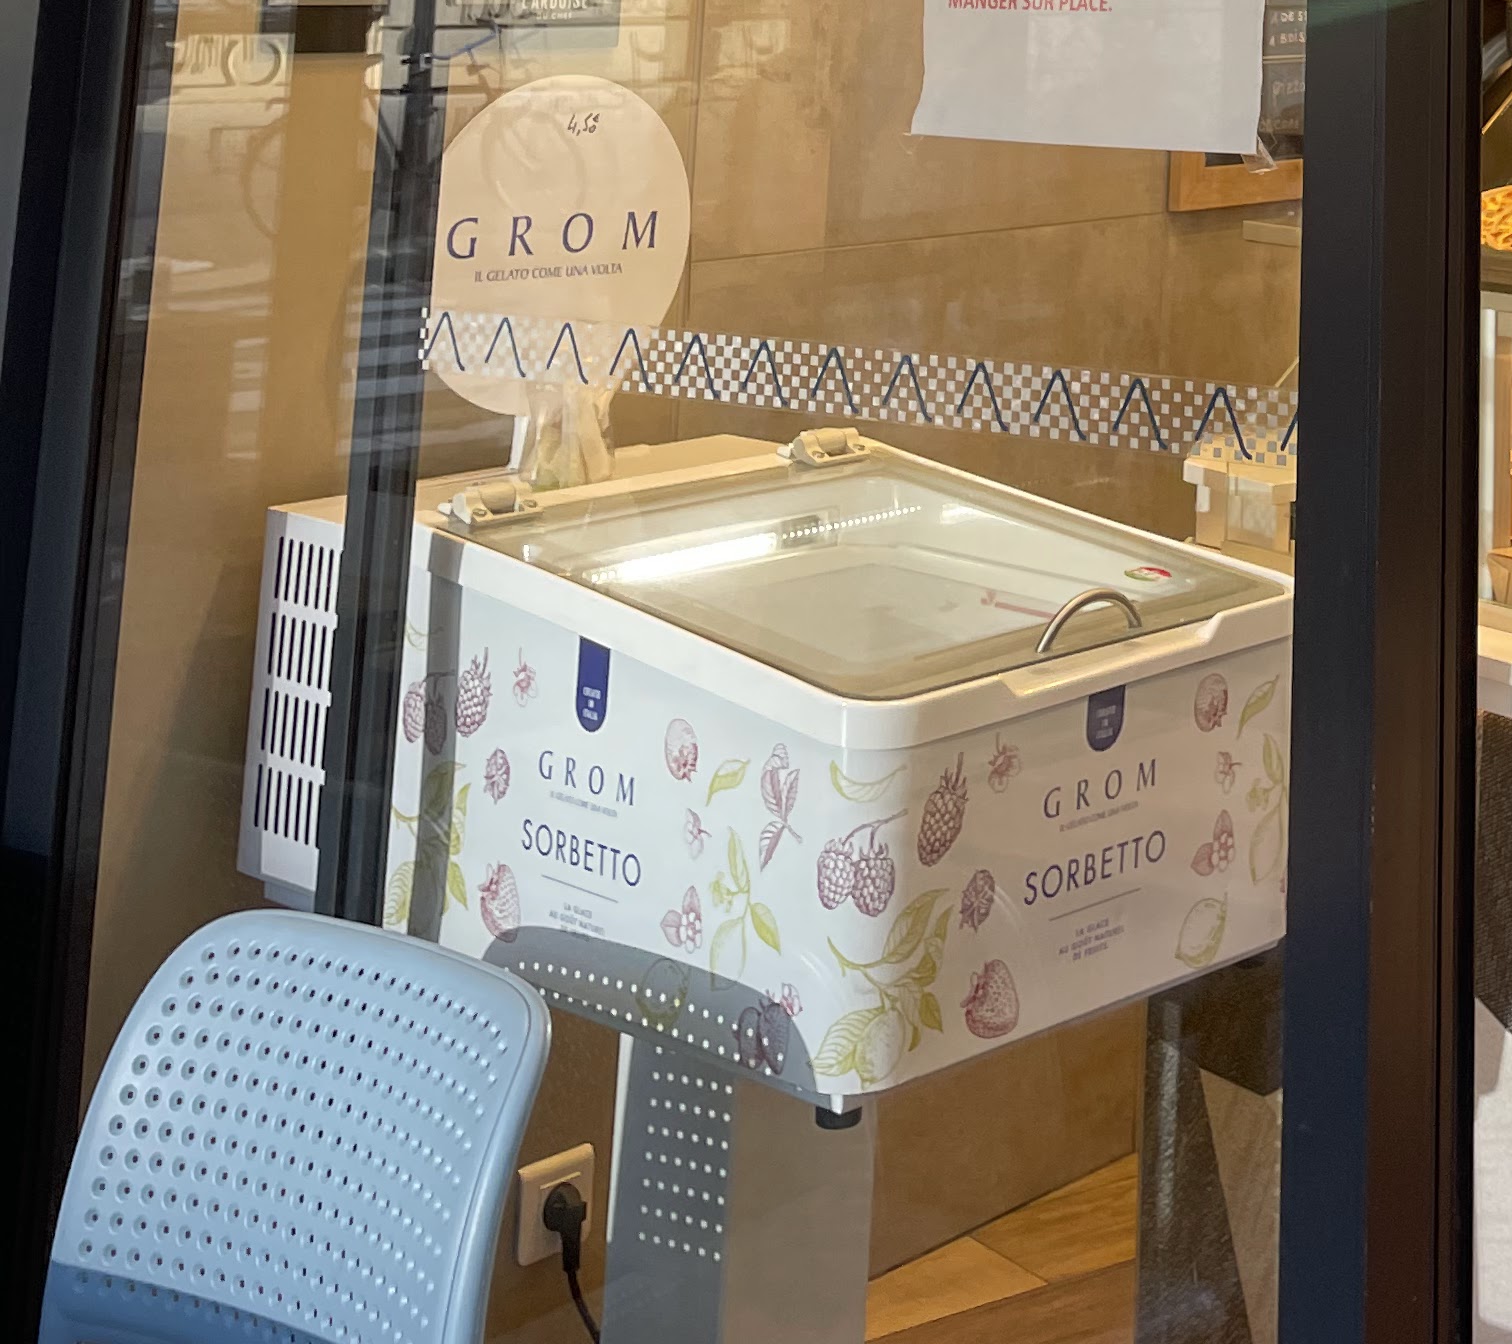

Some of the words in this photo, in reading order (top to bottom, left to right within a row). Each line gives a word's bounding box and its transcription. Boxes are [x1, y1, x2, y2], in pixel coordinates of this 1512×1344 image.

[446, 210, 658, 260] GROM
[485, 268, 530, 282] GELATO
[531, 266, 563, 279] COME
[565, 264, 589, 277] UNA
[590, 262, 623, 275] VOLTA
[539, 750, 635, 807] GROM
[1043, 759, 1156, 819] GROM
[521, 818, 642, 887] SORBETTO
[1023, 830, 1167, 906] SORBETTO
